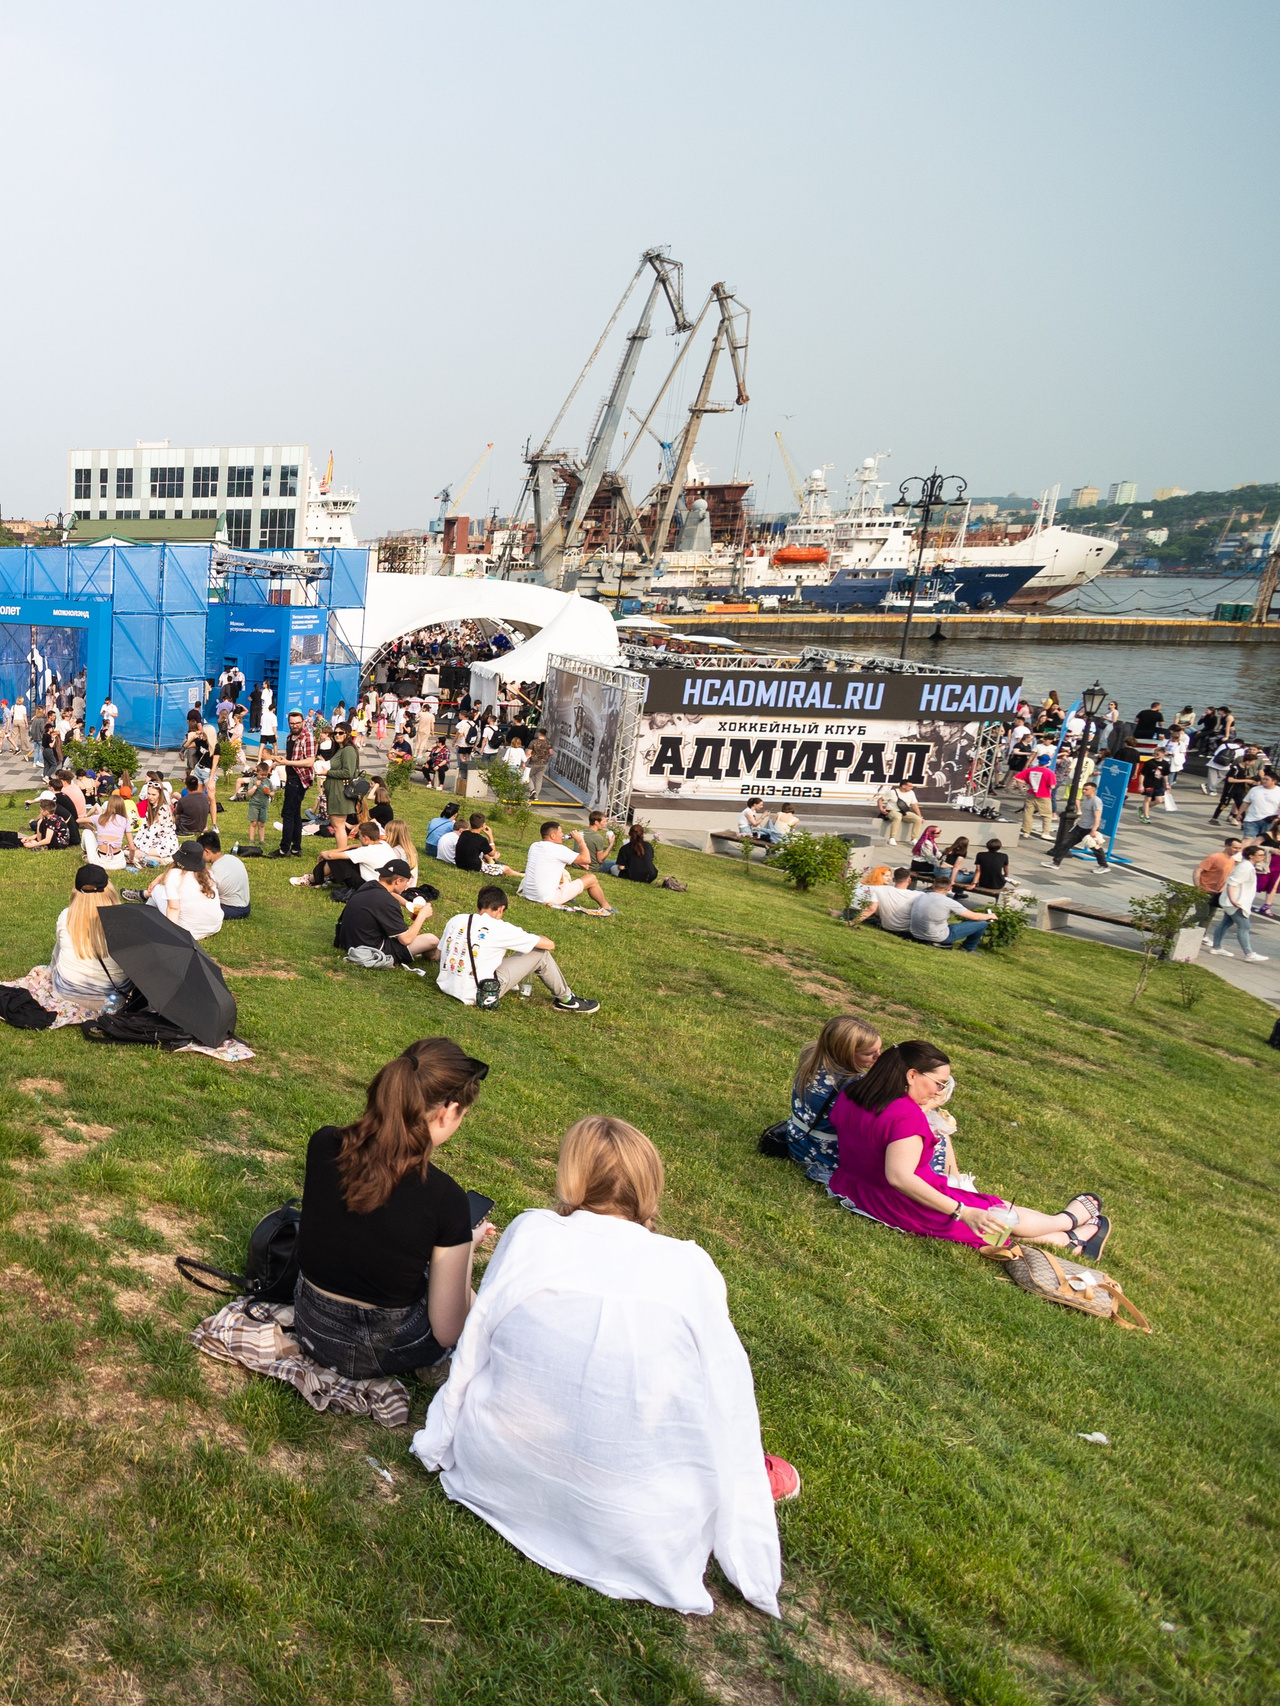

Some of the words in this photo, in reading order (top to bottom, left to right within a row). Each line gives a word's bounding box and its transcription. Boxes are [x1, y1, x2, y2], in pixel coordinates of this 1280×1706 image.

[682, 678, 885, 711] HCADMIRAL.RU
[919, 683, 1022, 714] HCADM
[718, 721, 819, 735] ХОККЕЙНЫЙ
[824, 724, 867, 736] КЛУБ
[648, 735, 930, 787] АДМИРАЛ
[740, 784, 822, 798] 2013-2023
